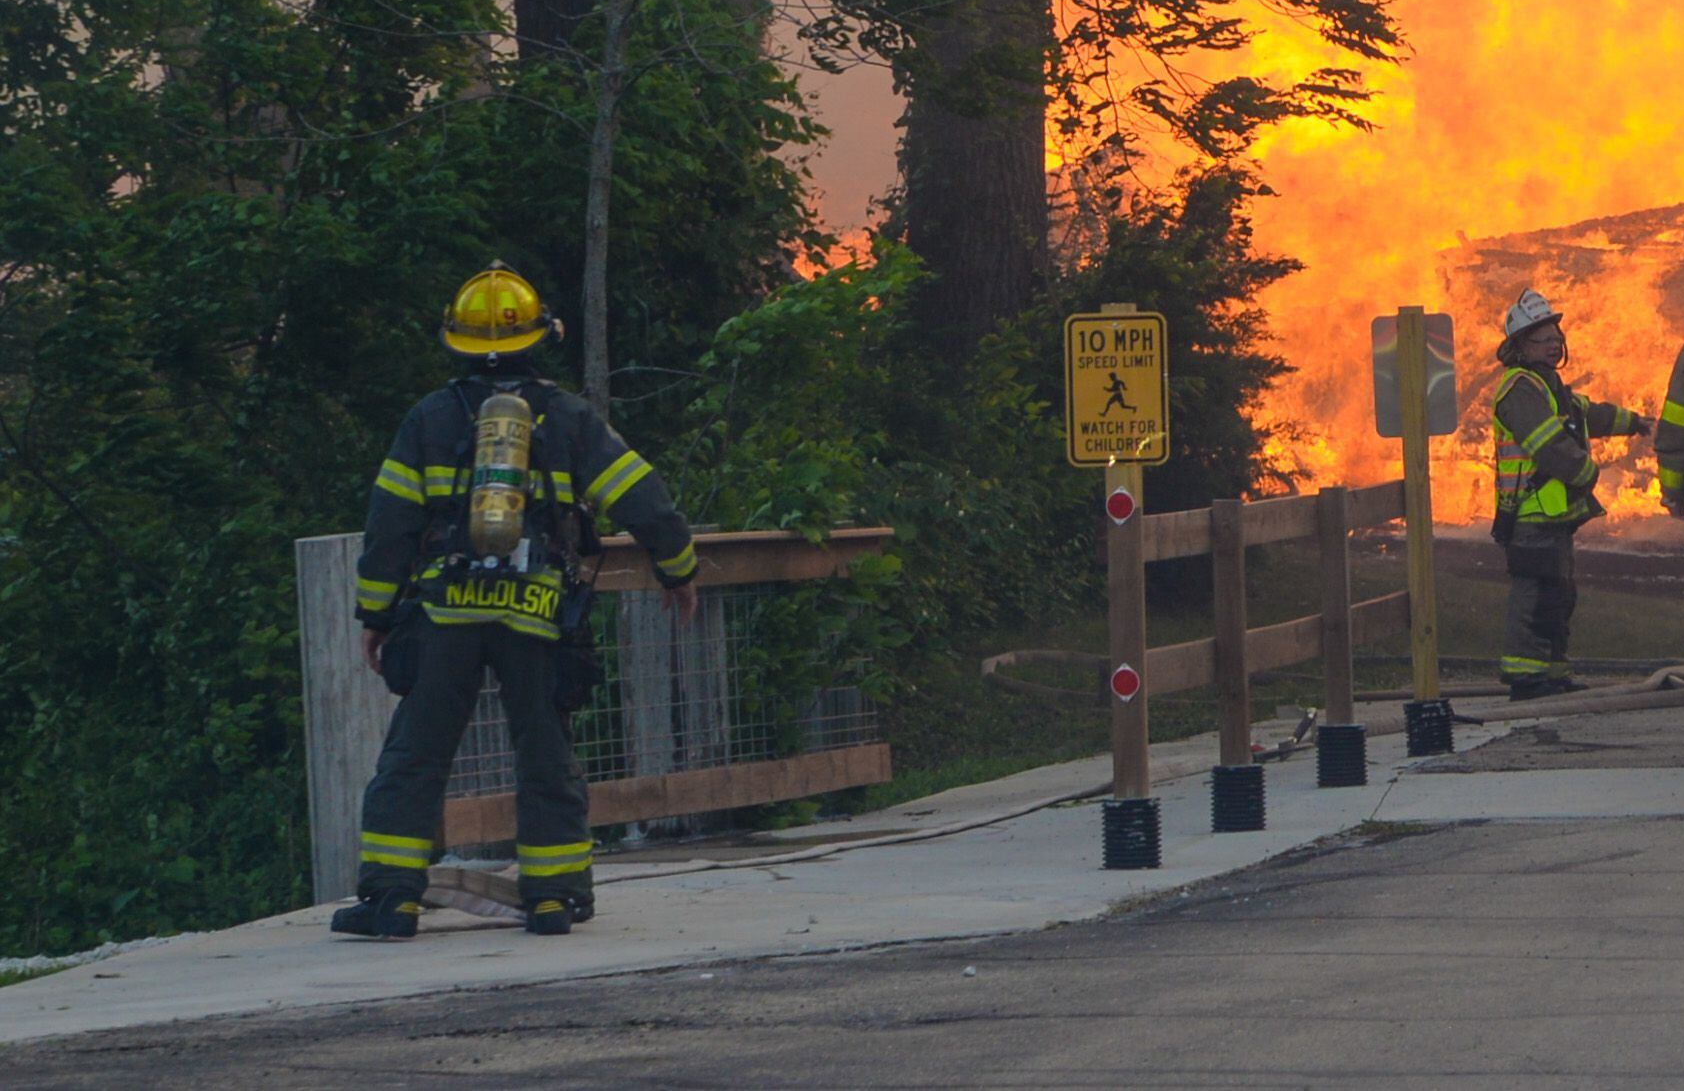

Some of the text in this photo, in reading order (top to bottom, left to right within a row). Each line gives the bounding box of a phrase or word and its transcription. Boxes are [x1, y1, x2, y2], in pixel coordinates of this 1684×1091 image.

[1078, 329, 1154, 353] 10 MPH
[1078, 355, 1155, 369] SPEED LIMIT
[1080, 420, 1156, 435] WATCH FOR
[1085, 438, 1152, 452] CHILDREN
